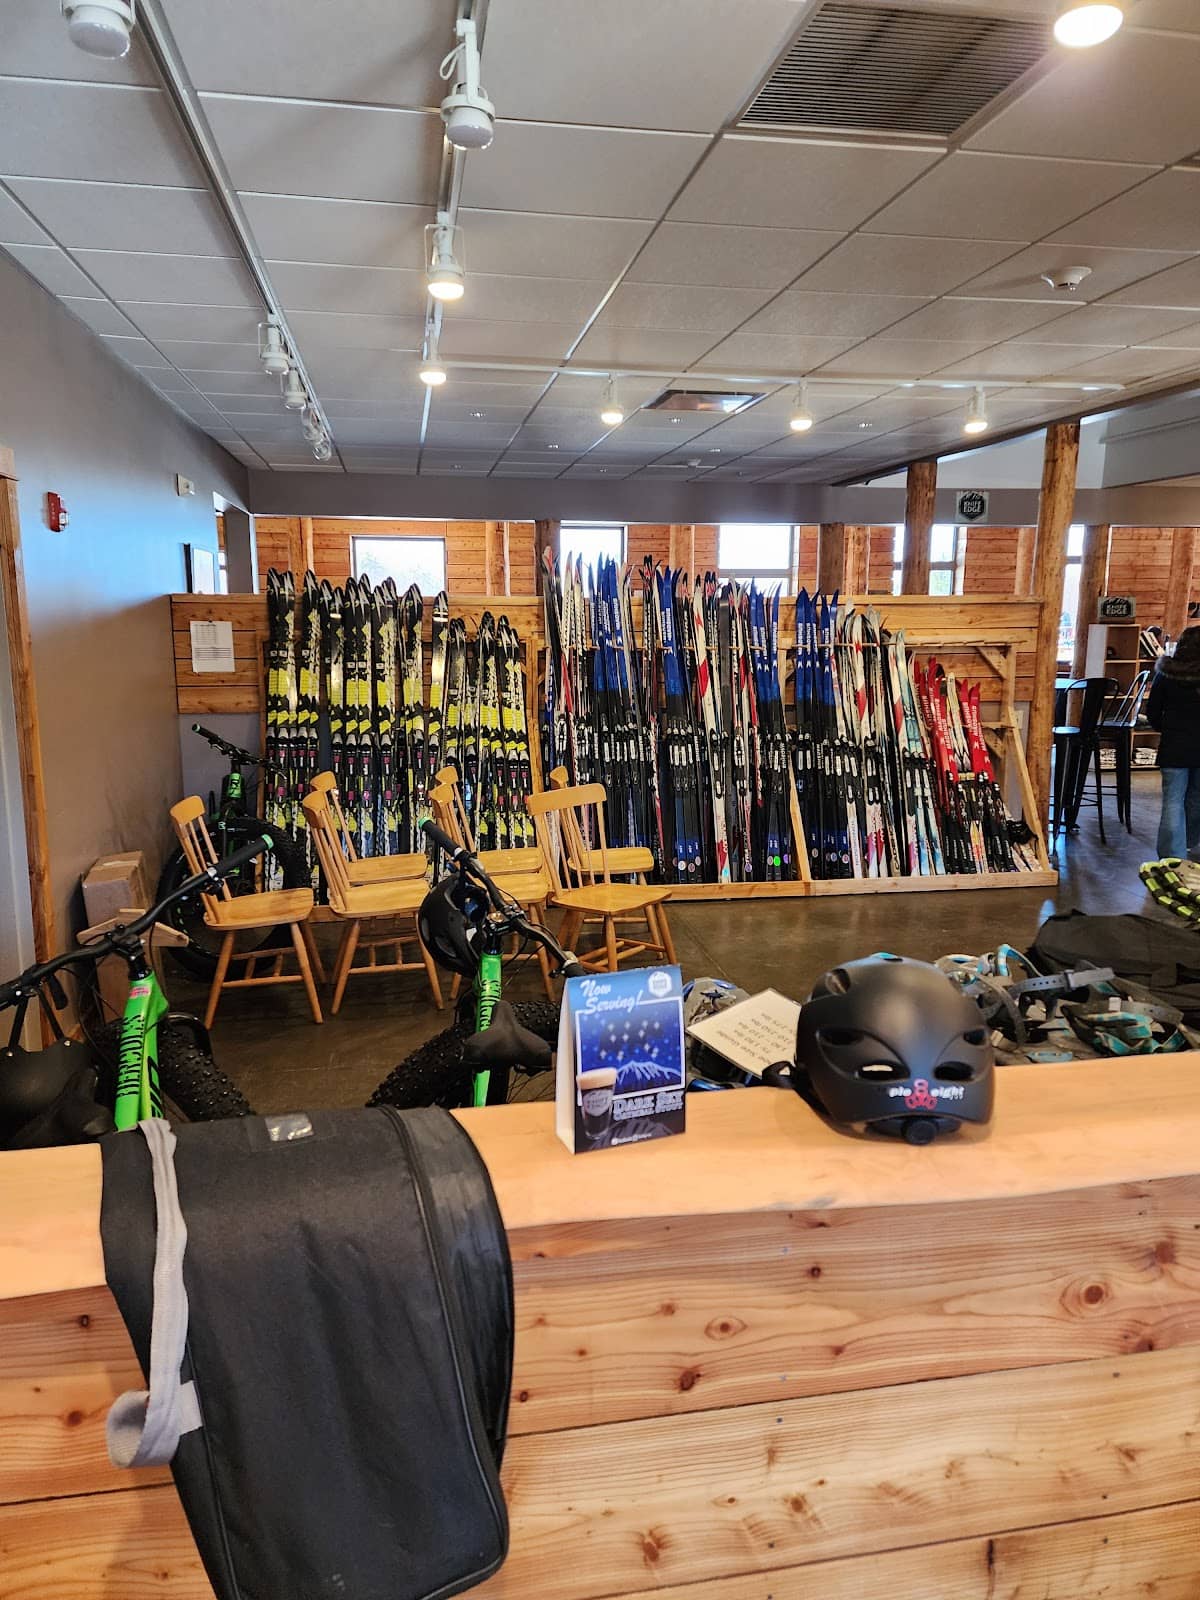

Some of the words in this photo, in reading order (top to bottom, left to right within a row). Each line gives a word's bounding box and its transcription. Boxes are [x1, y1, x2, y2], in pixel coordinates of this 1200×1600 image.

[580, 979, 612, 998] Now
[584, 989, 644, 1015] Serving!
[116, 1014, 144, 1097] HERCULES
[930, 1086, 965, 1100] eight
[613, 1095, 655, 1114] DARK
